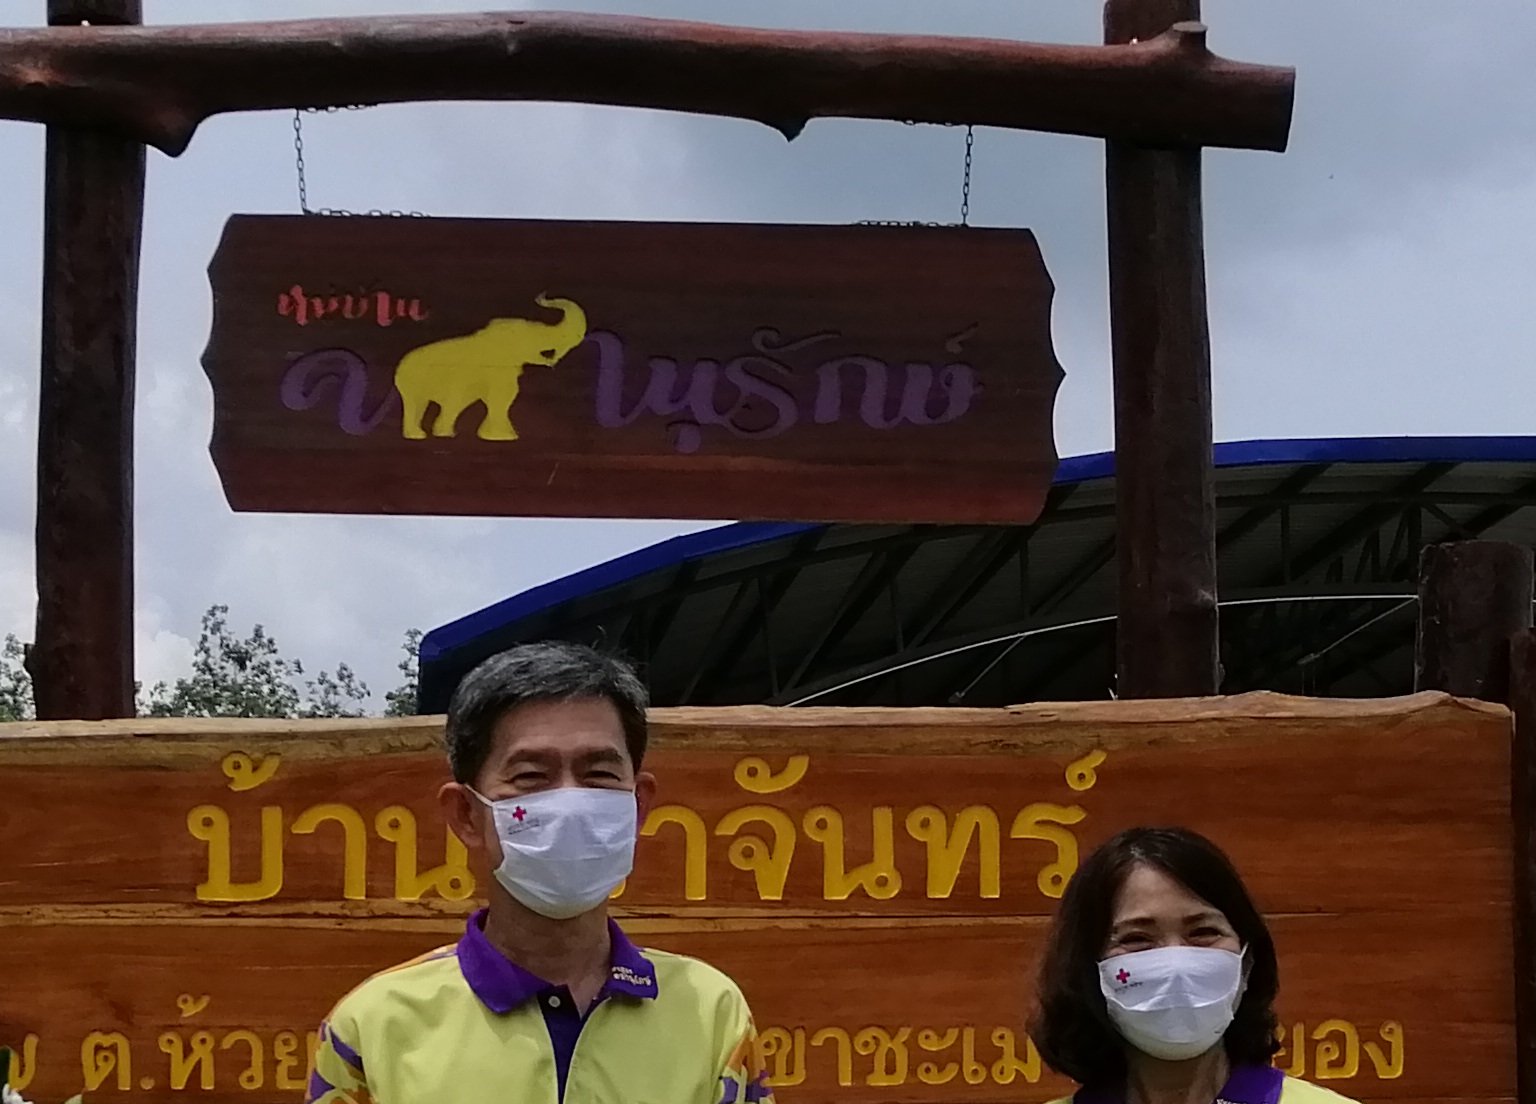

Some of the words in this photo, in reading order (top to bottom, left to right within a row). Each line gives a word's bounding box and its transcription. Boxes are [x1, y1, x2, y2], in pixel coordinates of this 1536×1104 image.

[609, 749, 1108, 900] าจันทร์
[762, 1024, 1041, 1087] ขาชะเม
